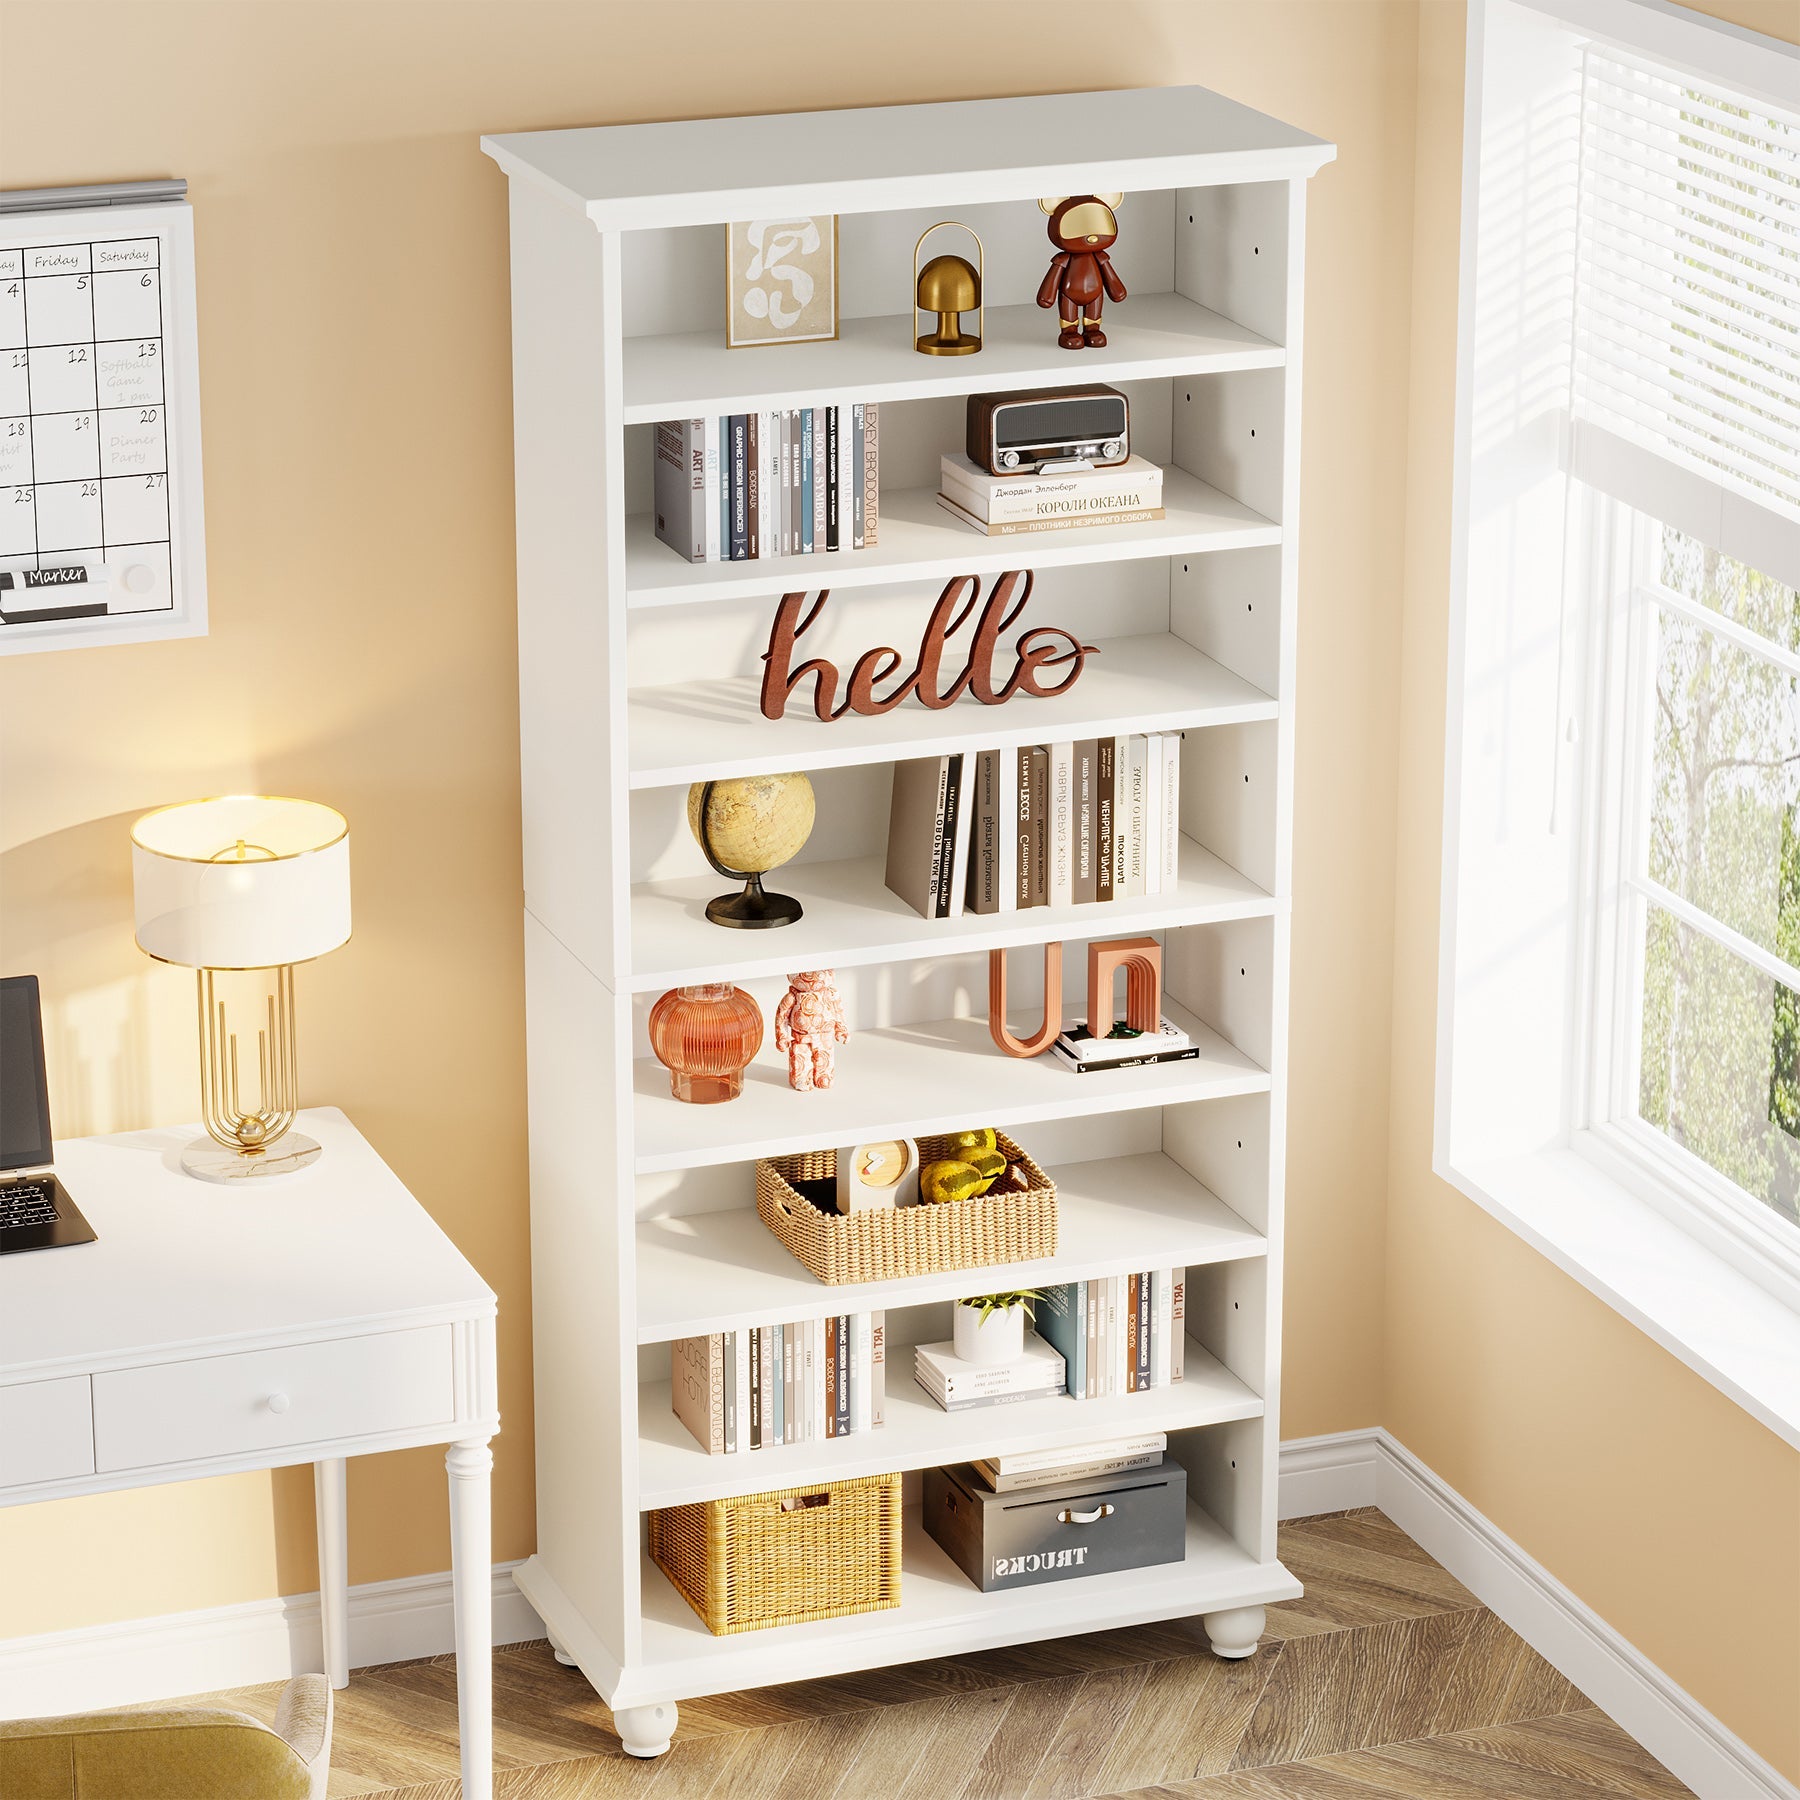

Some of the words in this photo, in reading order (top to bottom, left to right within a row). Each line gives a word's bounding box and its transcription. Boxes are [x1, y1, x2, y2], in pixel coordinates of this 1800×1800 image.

[34, 253, 79, 269] Friday
[100, 248, 150, 264] Saturday
[77, 275, 90, 290] 5
[140, 273, 152, 287] 6
[7, 284, 19, 299] 4
[68, 348, 88, 364] 12
[138, 343, 157, 358] 13
[12, 353, 29, 368] 11
[100, 358, 152, 373] Softball
[107, 375, 144, 388] Game
[74, 416, 90, 431] 19
[140, 410, 157, 424] 20
[8, 422, 25, 437] 18
[866, 404, 877, 446] LEXEY
[110, 434, 157, 448] Dinner
[815, 433, 824, 465] BOOK
[111, 450, 146, 465] Party
[693, 450, 703, 473] ART
[707, 449, 717, 471] ART
[146, 474, 164, 489] 27
[15, 489, 33, 502] 25
[81, 484, 97, 498] 26
[866, 451, 877, 538] BRODOVITCH
[995, 487, 1032, 498] Джордан
[1035, 483, 1077, 494] Элленберг
[815, 477, 824, 532] SYMBOLS
[1036, 499, 1088, 514] КОРОЛИ
[1090, 494, 1140, 509] ОКЕАНА
[1002, 526, 1016, 534] МЫ
[1030, 520, 1071, 530] ПЛОТНИКИ
[1073, 515, 1120, 527] НЕЗРИМОГО
[1122, 513, 1152, 521] СОБОРА
[30, 568, 84, 584] Marker
[761, 569, 1101, 723] hello
